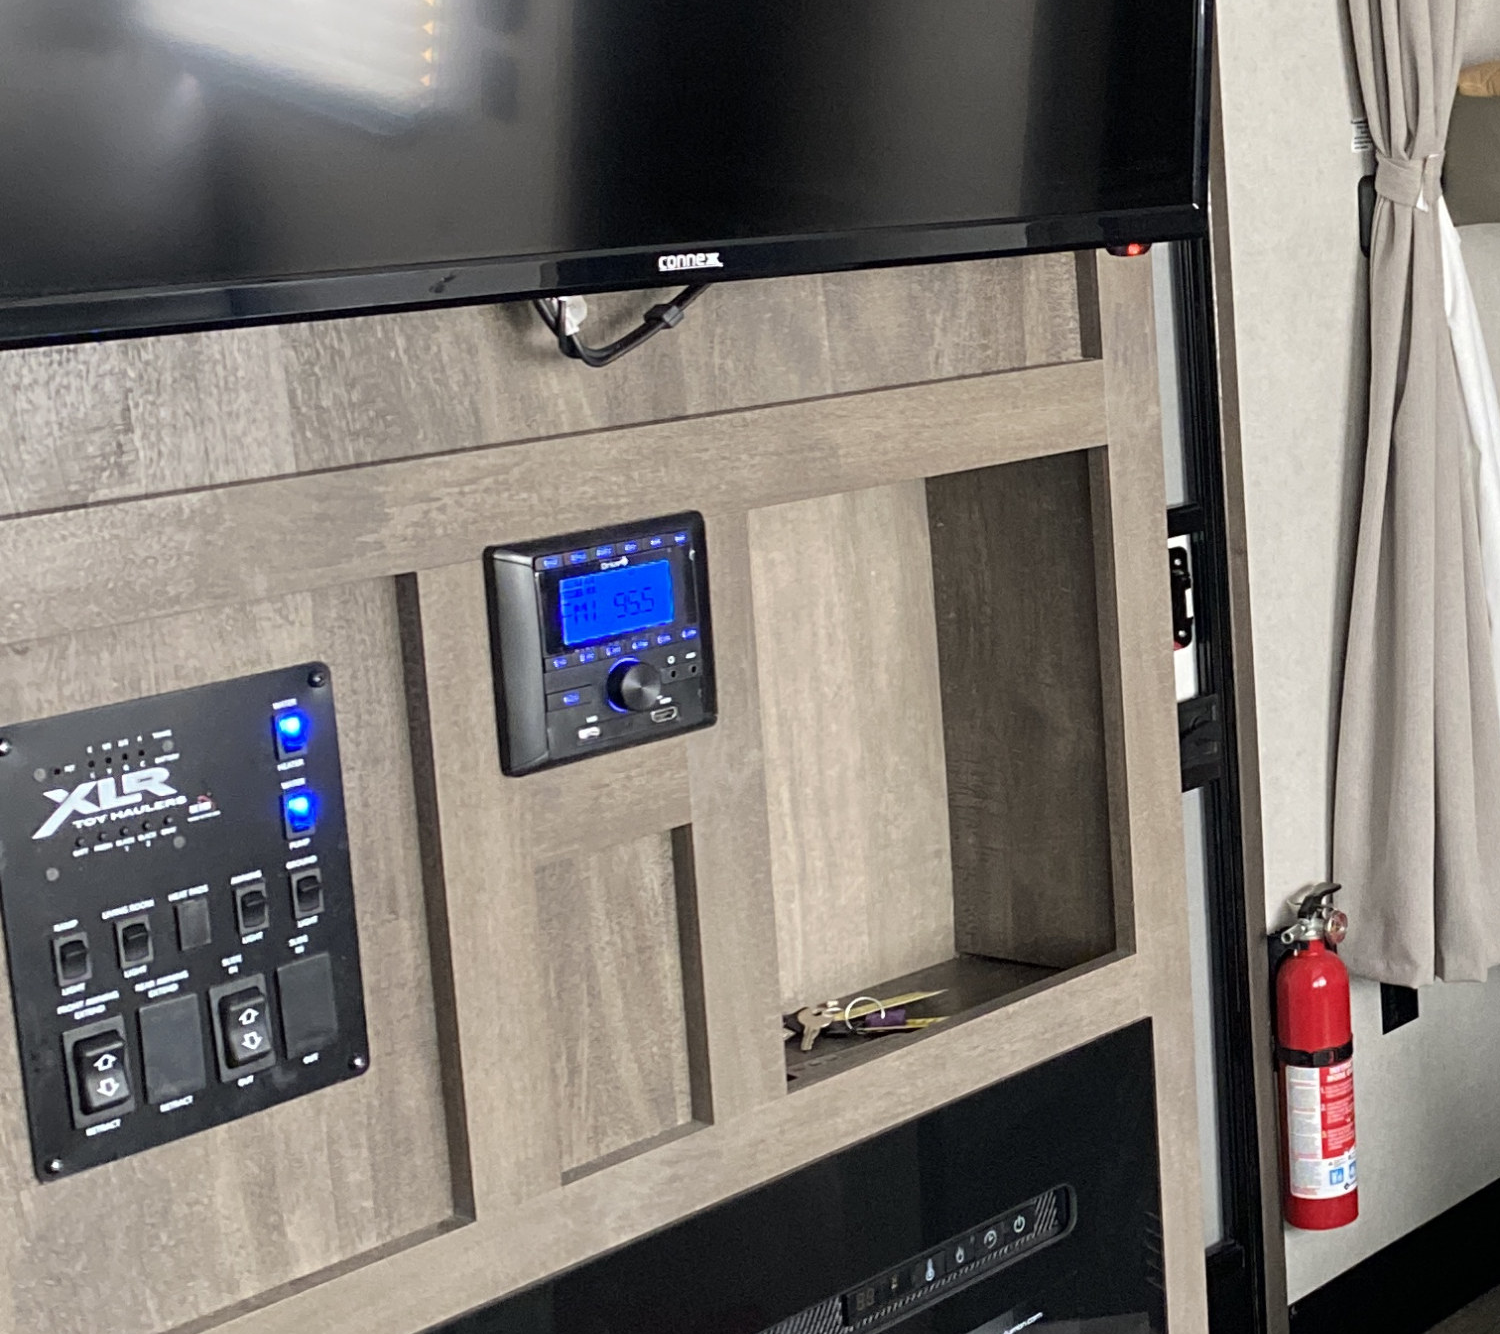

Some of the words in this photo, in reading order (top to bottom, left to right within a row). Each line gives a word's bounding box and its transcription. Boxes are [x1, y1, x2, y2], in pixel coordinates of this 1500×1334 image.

[658, 252, 723, 272] connex
[32, 767, 178, 840] XLR
[72, 814, 107, 829] TOY
[109, 795, 188, 821] HAULERS
[297, 915, 318, 928] LIGHT
[242, 931, 263, 945] LIGHT
[123, 964, 147, 978] LIGHT
[61, 982, 85, 996] LIGHT
